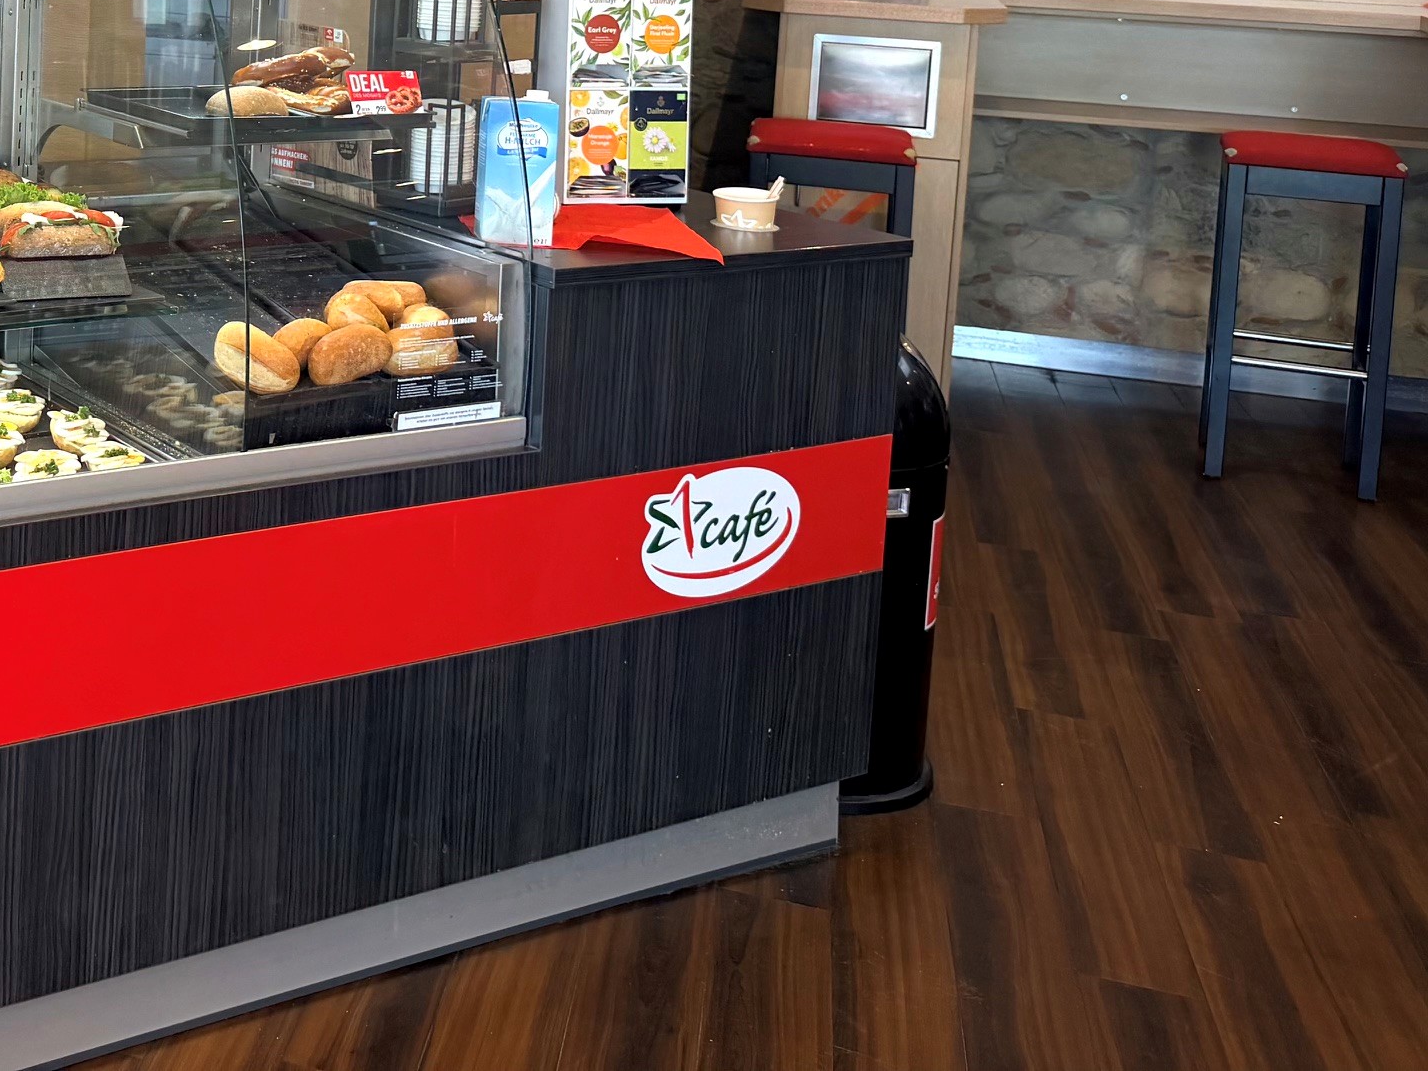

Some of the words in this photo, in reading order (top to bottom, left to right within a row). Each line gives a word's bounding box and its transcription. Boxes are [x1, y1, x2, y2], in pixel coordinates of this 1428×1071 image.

[588, 26, 601, 34] Earl
[602, 27, 617, 35] Grey
[349, 73, 390, 93] DEAL
[586, 107, 614, 116] Dallmayr
[700, 490, 779, 562] café
